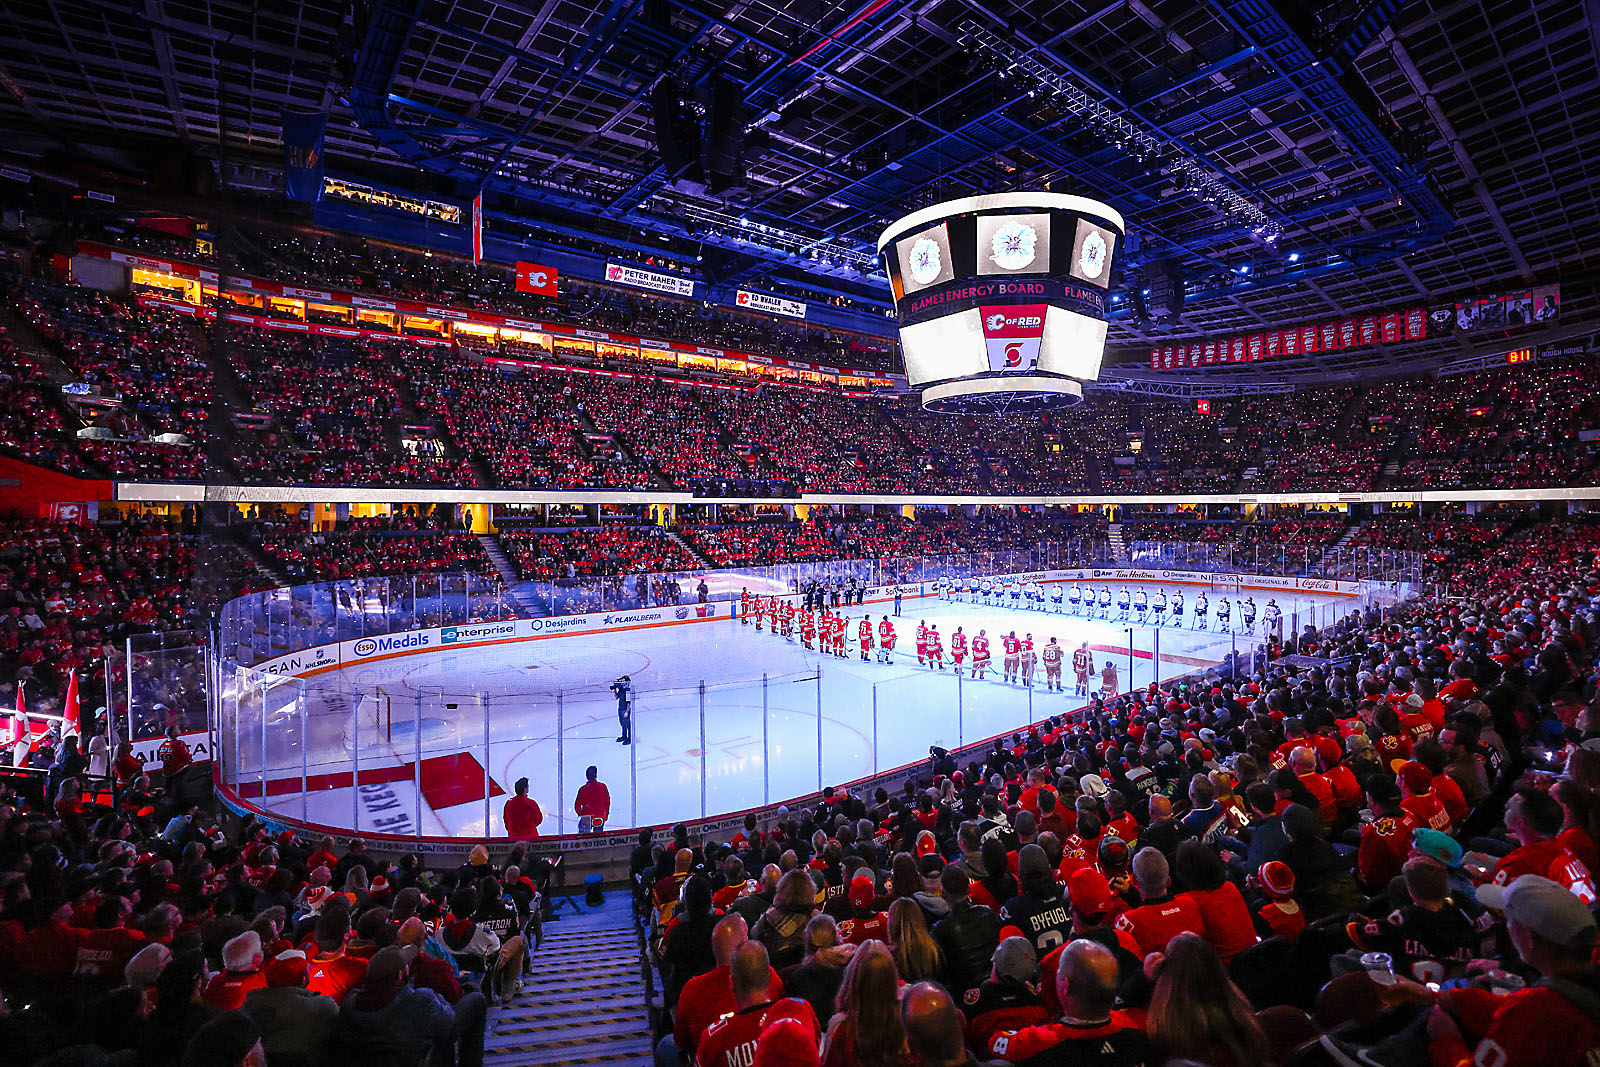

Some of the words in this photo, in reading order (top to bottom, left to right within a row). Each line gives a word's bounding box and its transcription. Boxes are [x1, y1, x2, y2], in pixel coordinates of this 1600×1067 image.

[624, 269, 650, 281] PETER
[651, 274, 676, 287] MAHER
[638, 279, 662, 290] BROADCAST
[751, 293, 759, 302] ED
[760, 295, 781, 307] WHALEN
[911, 294, 945, 312] FLAMES
[946, 284, 995, 305] ENERGY
[999, 283, 1045, 295] BOARD
[1065, 286, 1096, 303] FLAMES
[1018, 316, 1042, 326] RED
[1563, 346, 1584, 355] HOUSE
[1115, 569, 1128, 578] Tim
[1128, 570, 1156, 579] Hortons
[545, 617, 587, 629] Desjardins
[614, 613, 662, 624] PLAYALBERTA
[443, 625, 515, 643] enterprise
[380, 632, 430, 653] Medals
[1045, 650, 1056, 661] 28
[1160, 906, 1181, 917] Reebok
[1029, 906, 1073, 933] BYFUGL
[724, 1039, 759, 1067] MO
